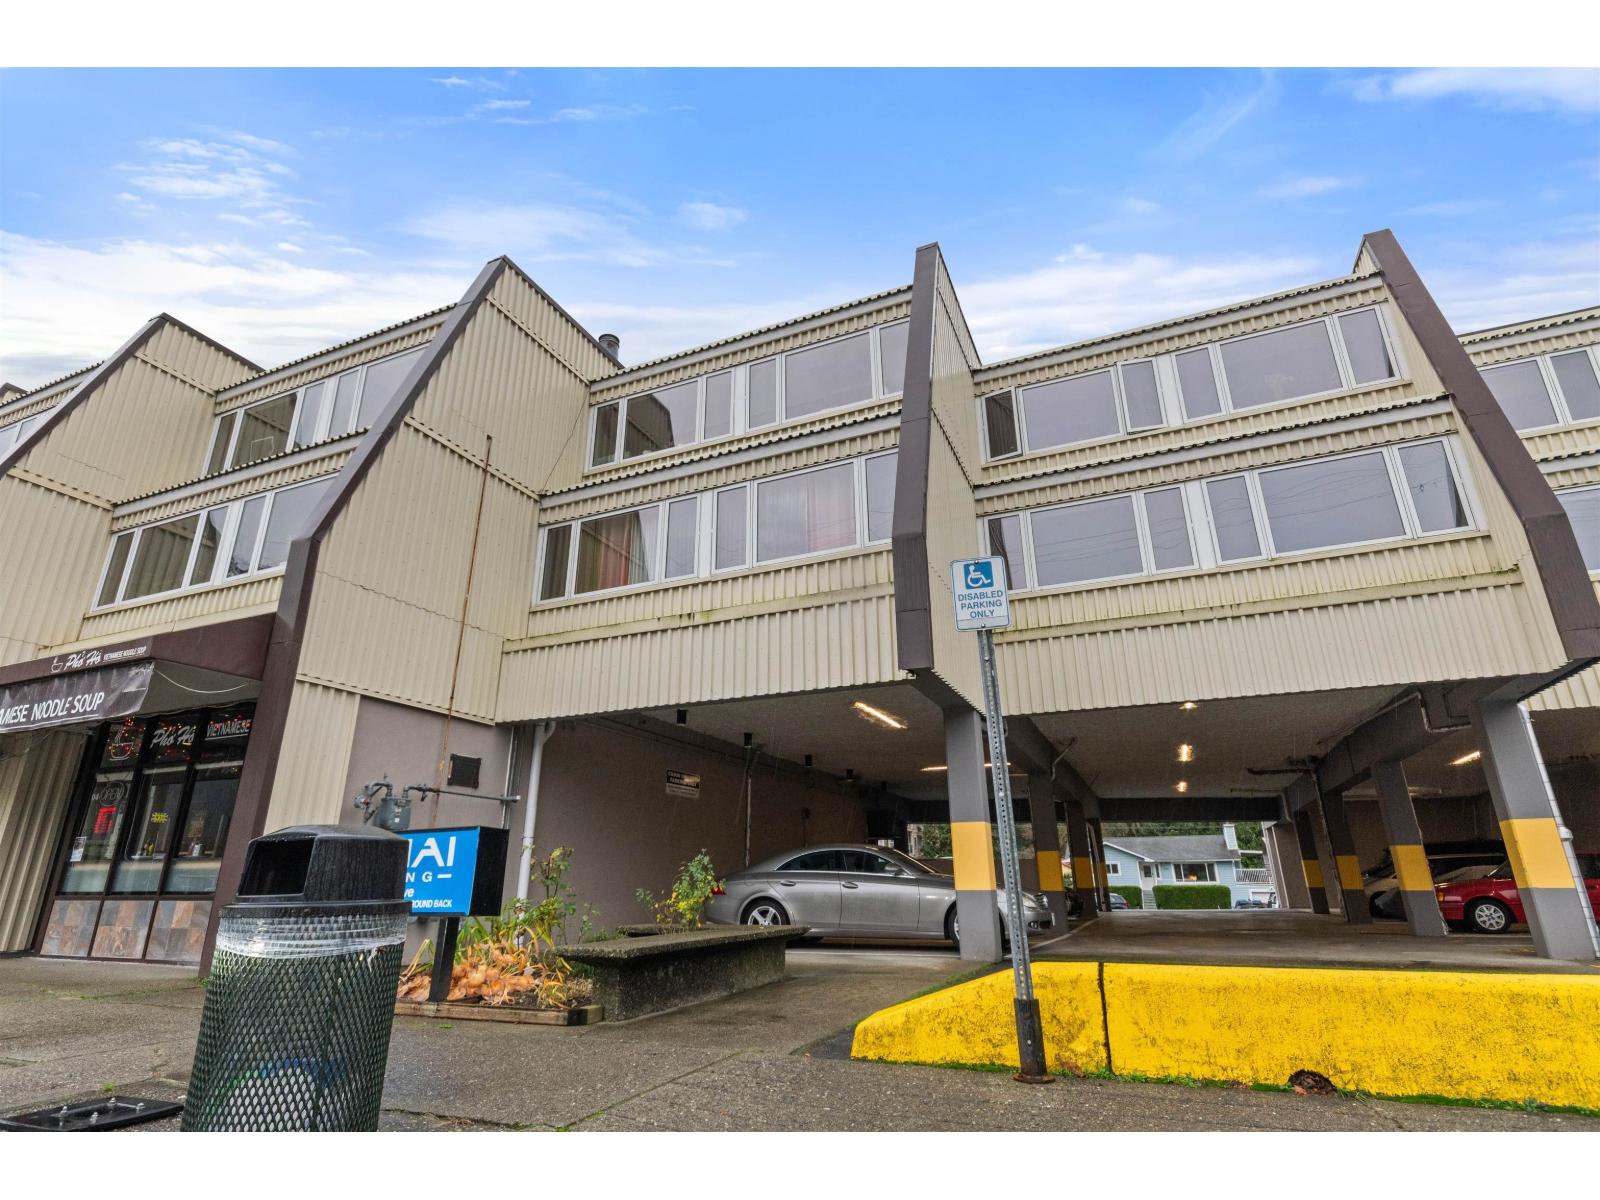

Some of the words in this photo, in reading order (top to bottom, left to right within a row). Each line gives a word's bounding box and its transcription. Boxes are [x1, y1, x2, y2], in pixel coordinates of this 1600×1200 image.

[957, 590, 1004, 602] DISABLED
[960, 600, 1003, 611] PARKING
[969, 609, 995, 619] ONLY
[31, 697, 73, 721] NOODLE
[71, 691, 105, 714] SOUP
[206, 720, 251, 738] VIETNAMESE
[433, 899, 453, 908] BACK
